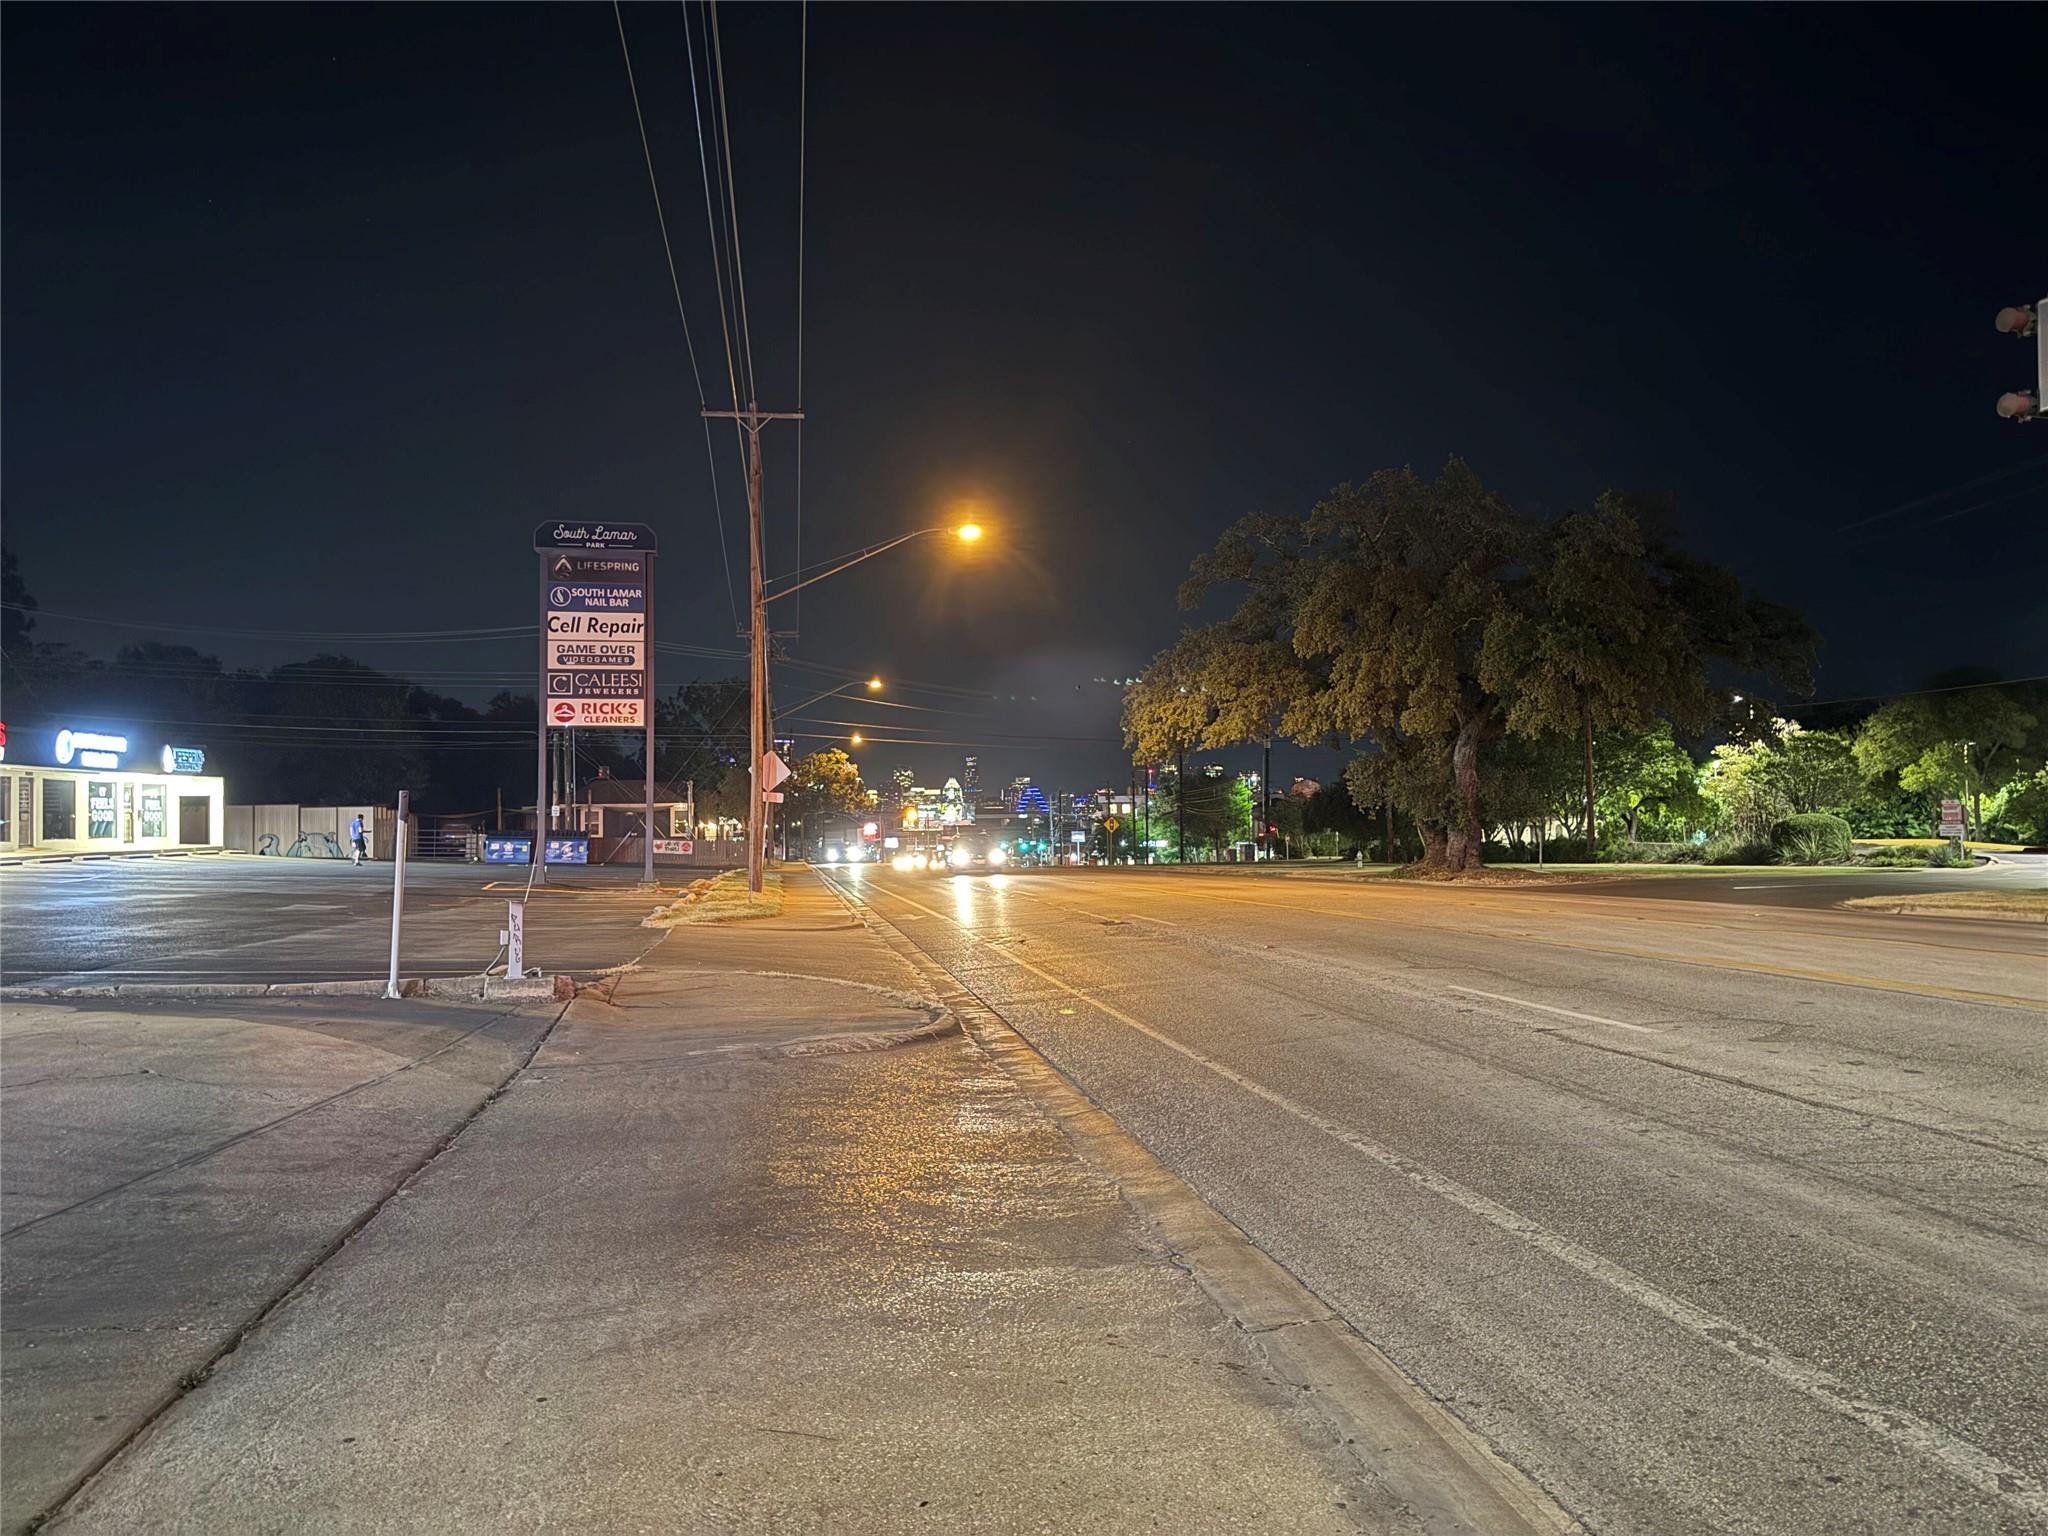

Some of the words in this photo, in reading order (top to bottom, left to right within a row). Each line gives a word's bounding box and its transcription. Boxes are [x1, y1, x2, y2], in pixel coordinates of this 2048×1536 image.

[553, 523, 589, 540] South
[591, 525, 638, 541] Lamar
[577, 561, 640, 572] LIFESPRING
[571, 588, 605, 598] SOUTH
[607, 589, 642, 599] LAMAR
[585, 598, 608, 607] NAIL
[609, 599, 630, 608] BAR
[548, 616, 581, 633] Cell
[586, 617, 644, 638] Repair
[556, 644, 596, 654] GAME
[600, 645, 635, 655] OVER
[575, 673, 643, 688] CALEESI
[581, 702, 638, 715] RICK'S
[583, 716, 636, 724] CLEANERS
